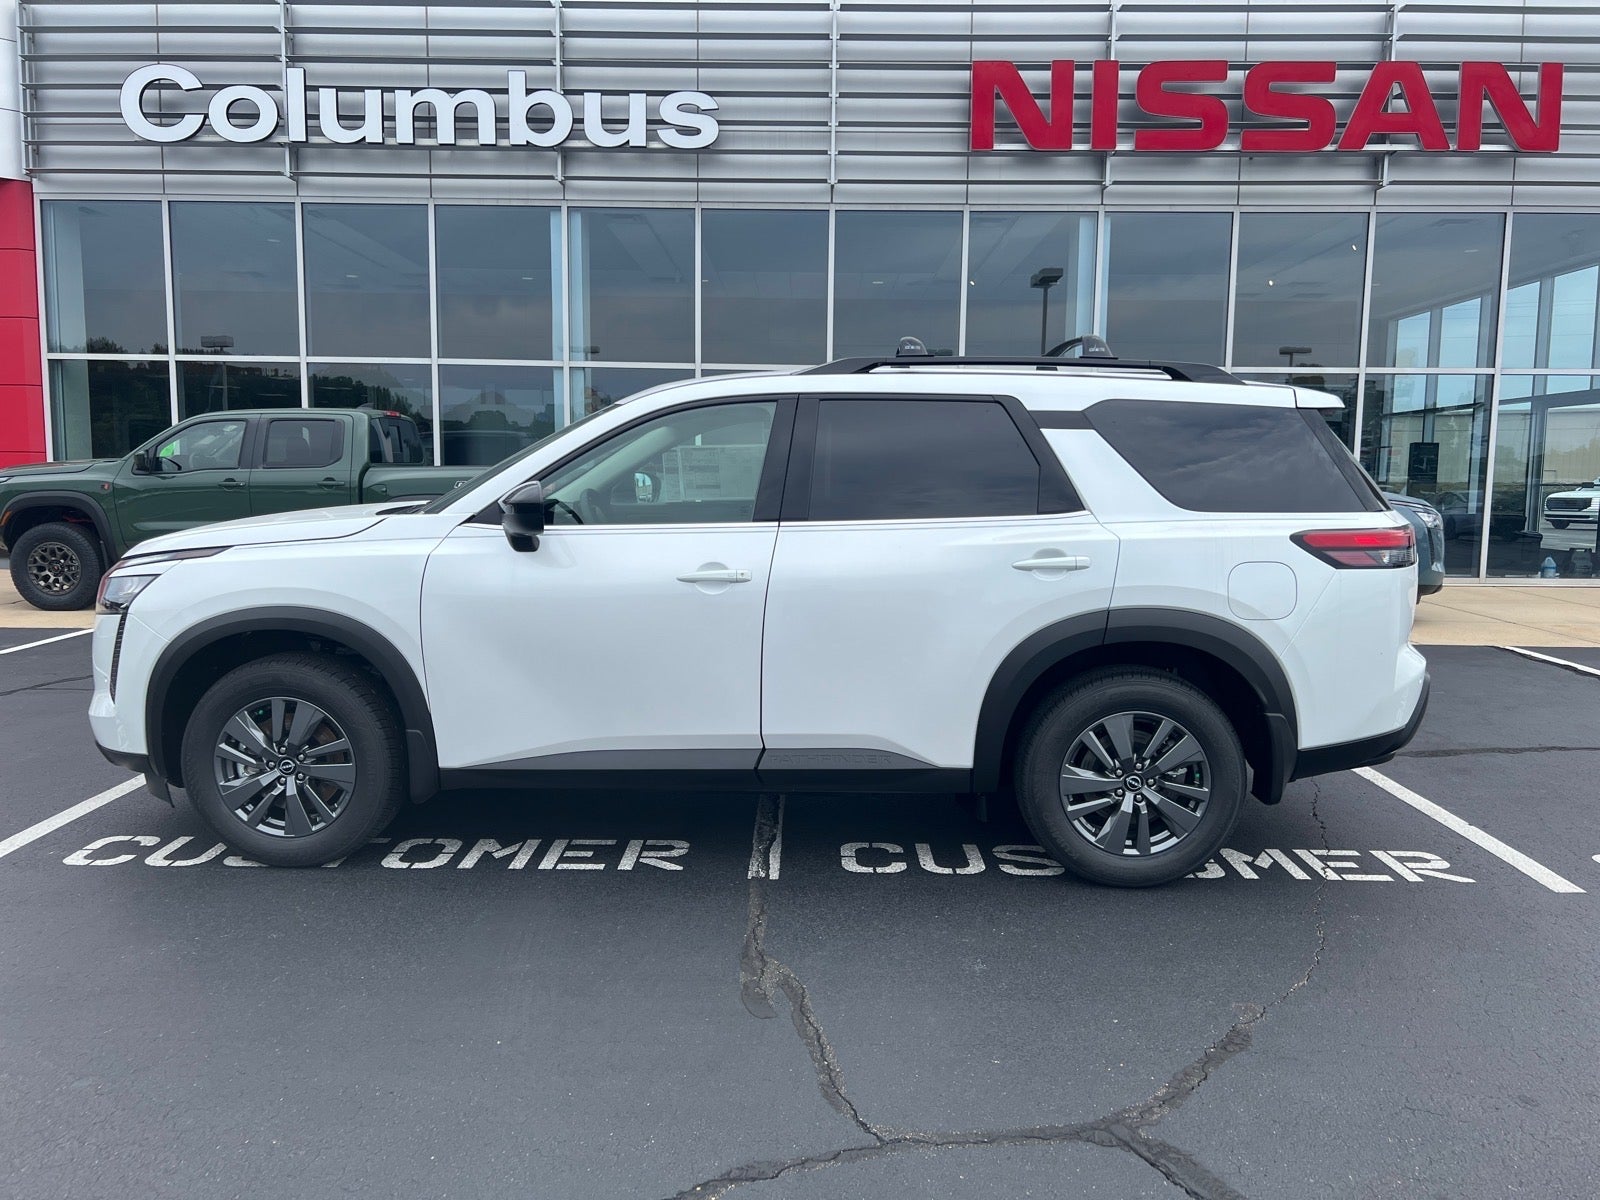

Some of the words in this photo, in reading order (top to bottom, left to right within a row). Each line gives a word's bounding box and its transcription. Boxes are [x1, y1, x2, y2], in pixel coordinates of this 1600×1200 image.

[119, 63, 721, 149] Columbus
[970, 60, 1564, 153] NISSAN
[62, 835, 691, 871] CUOMER
[840, 842, 1476, 883] CUSMER
